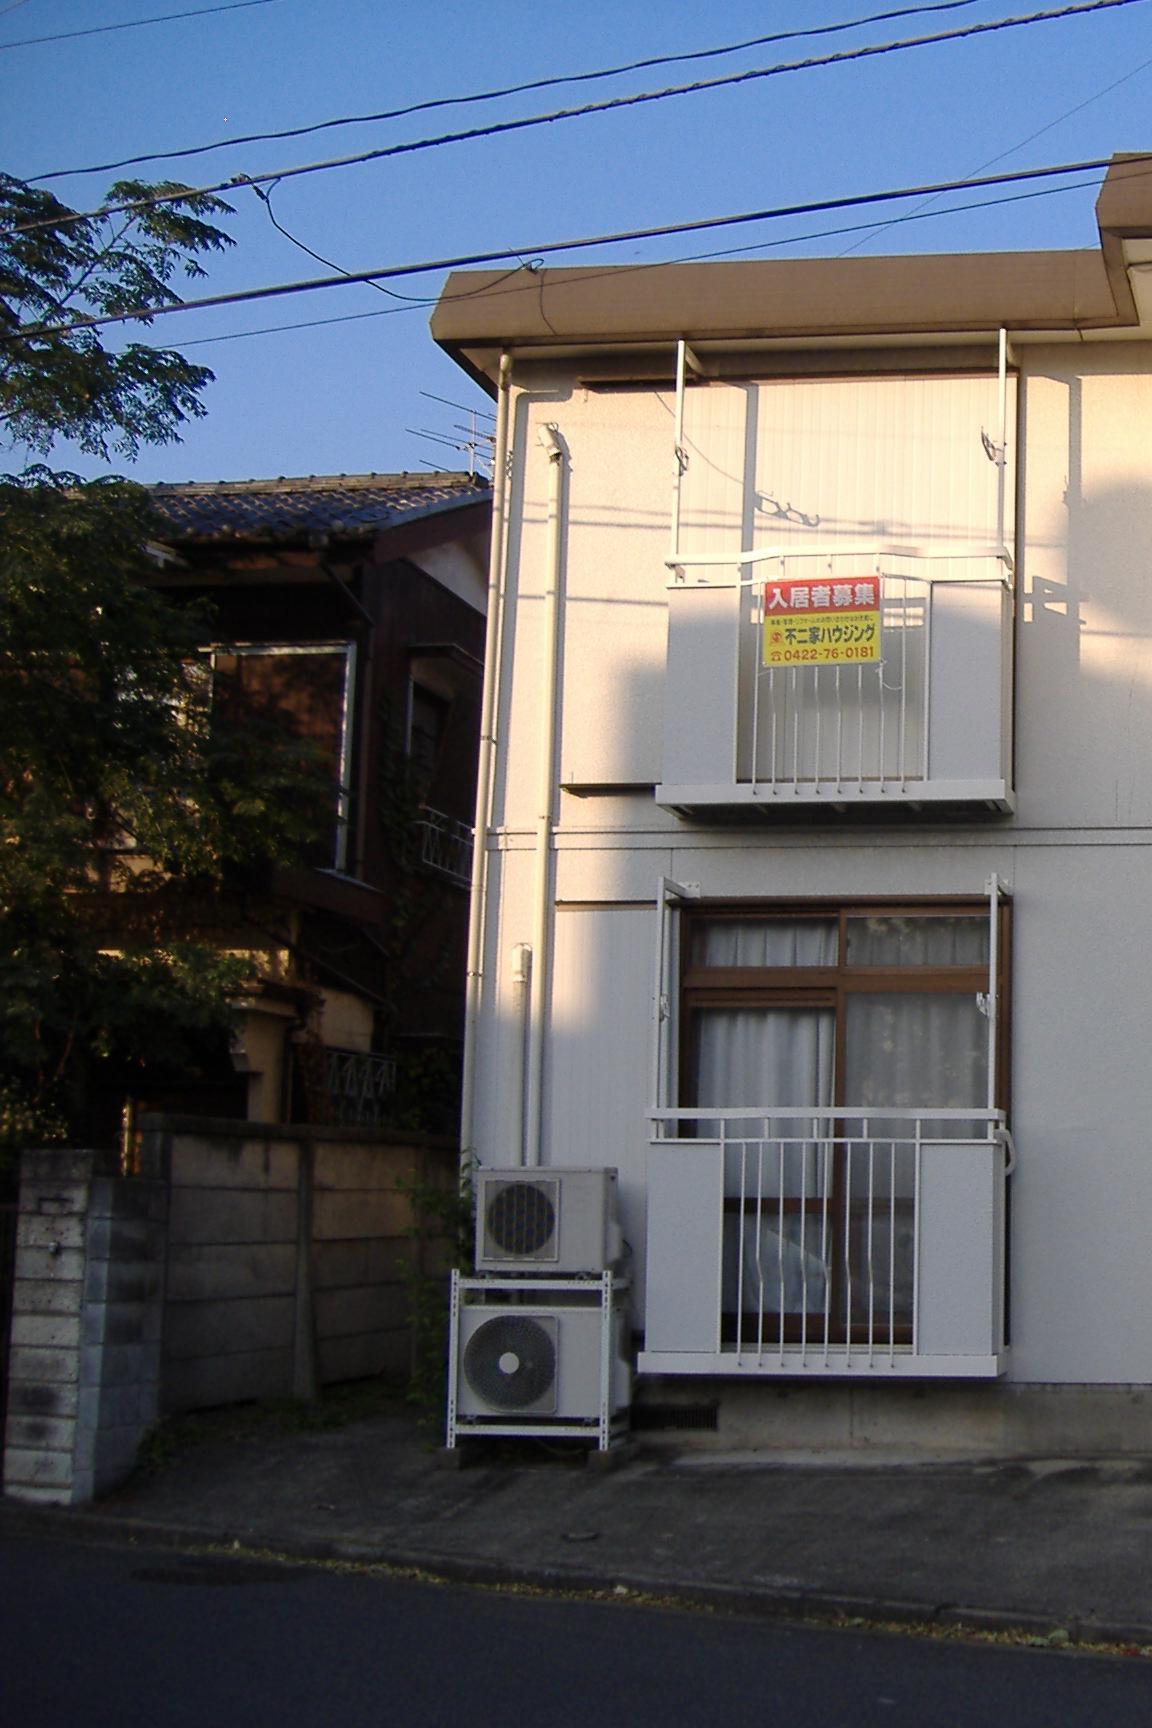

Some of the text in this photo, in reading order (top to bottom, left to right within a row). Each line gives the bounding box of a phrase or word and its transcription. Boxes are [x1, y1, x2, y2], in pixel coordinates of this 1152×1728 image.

[769, 583, 874, 608] 入居者募集
[785, 624, 875, 645] 不二家ハウジング
